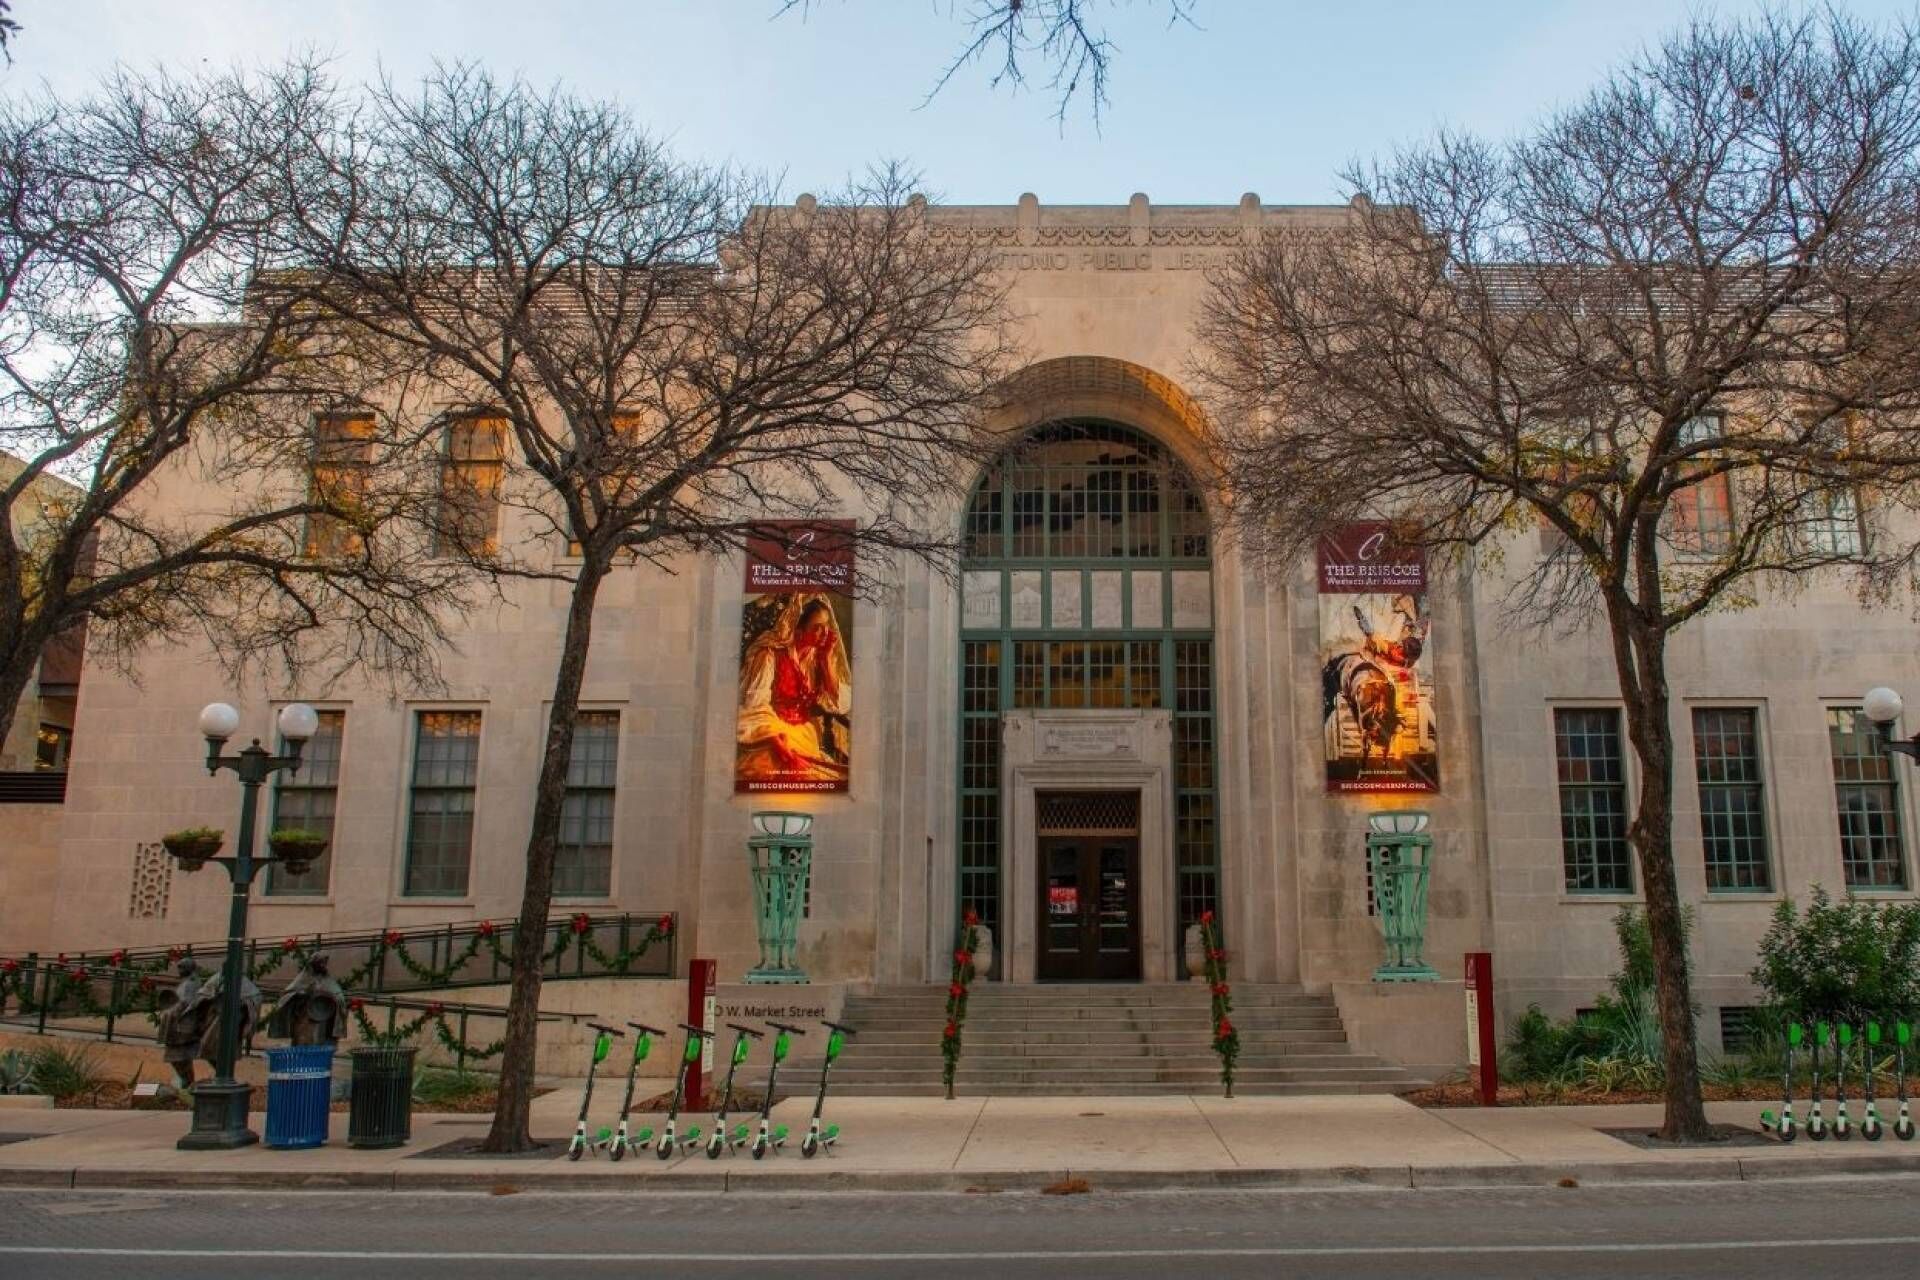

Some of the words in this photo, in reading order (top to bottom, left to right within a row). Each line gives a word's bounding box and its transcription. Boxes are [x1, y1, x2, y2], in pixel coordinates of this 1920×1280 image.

[977, 253, 1069, 271] NTONIO
[1081, 253, 1152, 271] PUBLIC
[1325, 564, 1355, 576] THE
[1358, 564, 1421, 576] BRISCOE
[727, 1005, 741, 1017] W.
[744, 1004, 785, 1017] Market
[788, 1004, 826, 1017] Street
